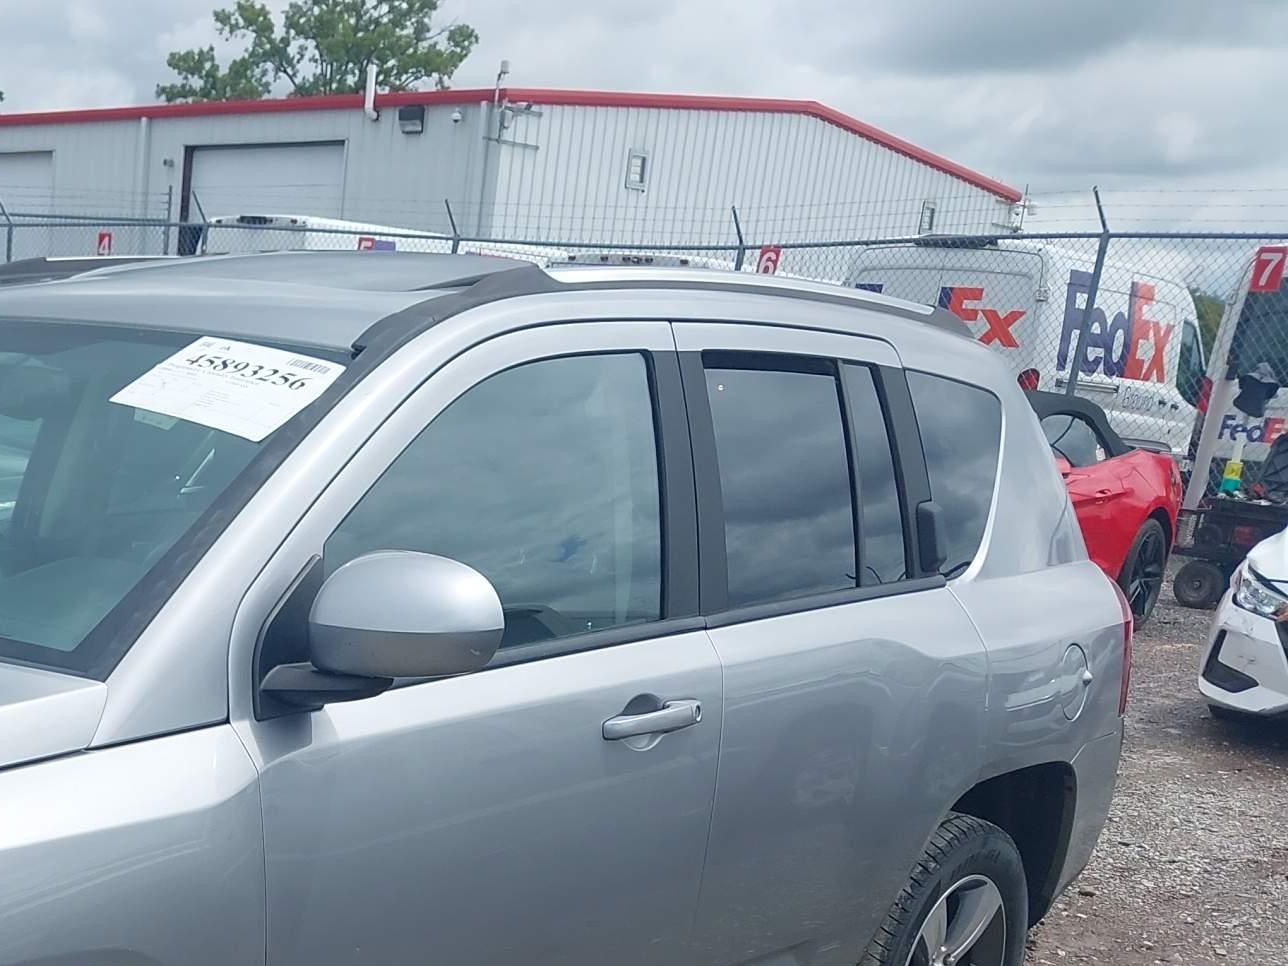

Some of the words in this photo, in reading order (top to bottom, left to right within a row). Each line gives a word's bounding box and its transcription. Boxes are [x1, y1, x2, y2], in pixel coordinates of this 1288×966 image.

[758, 251, 777, 274] 6
[1257, 252, 1283, 286] 7
[1056, 269, 1175, 384] FedEx
[185, 353, 313, 391] 45893256
[1217, 414, 1286, 444] FedE
